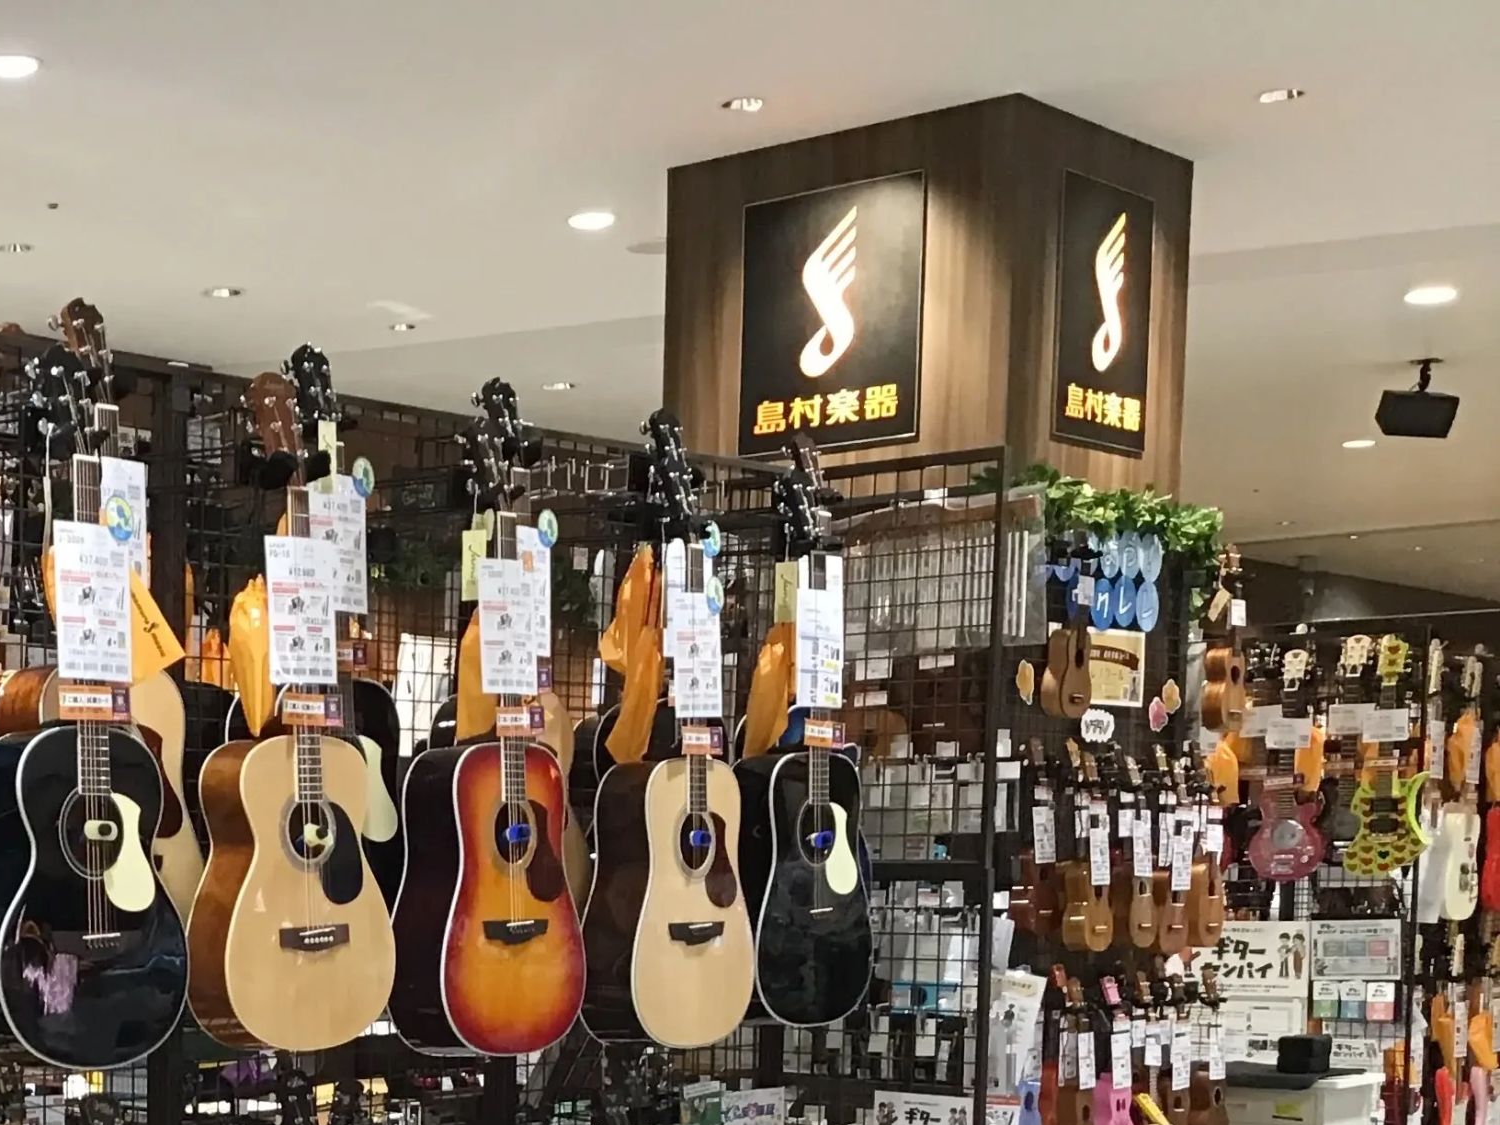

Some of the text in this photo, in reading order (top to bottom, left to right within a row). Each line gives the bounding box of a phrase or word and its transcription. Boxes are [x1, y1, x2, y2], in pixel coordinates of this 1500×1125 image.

[753, 383, 899, 435] 島村楽器
[1065, 383, 1141, 433] 島村楽器
[1212, 937, 1266, 960] ギター
[905, 1107, 941, 1125] ギター
